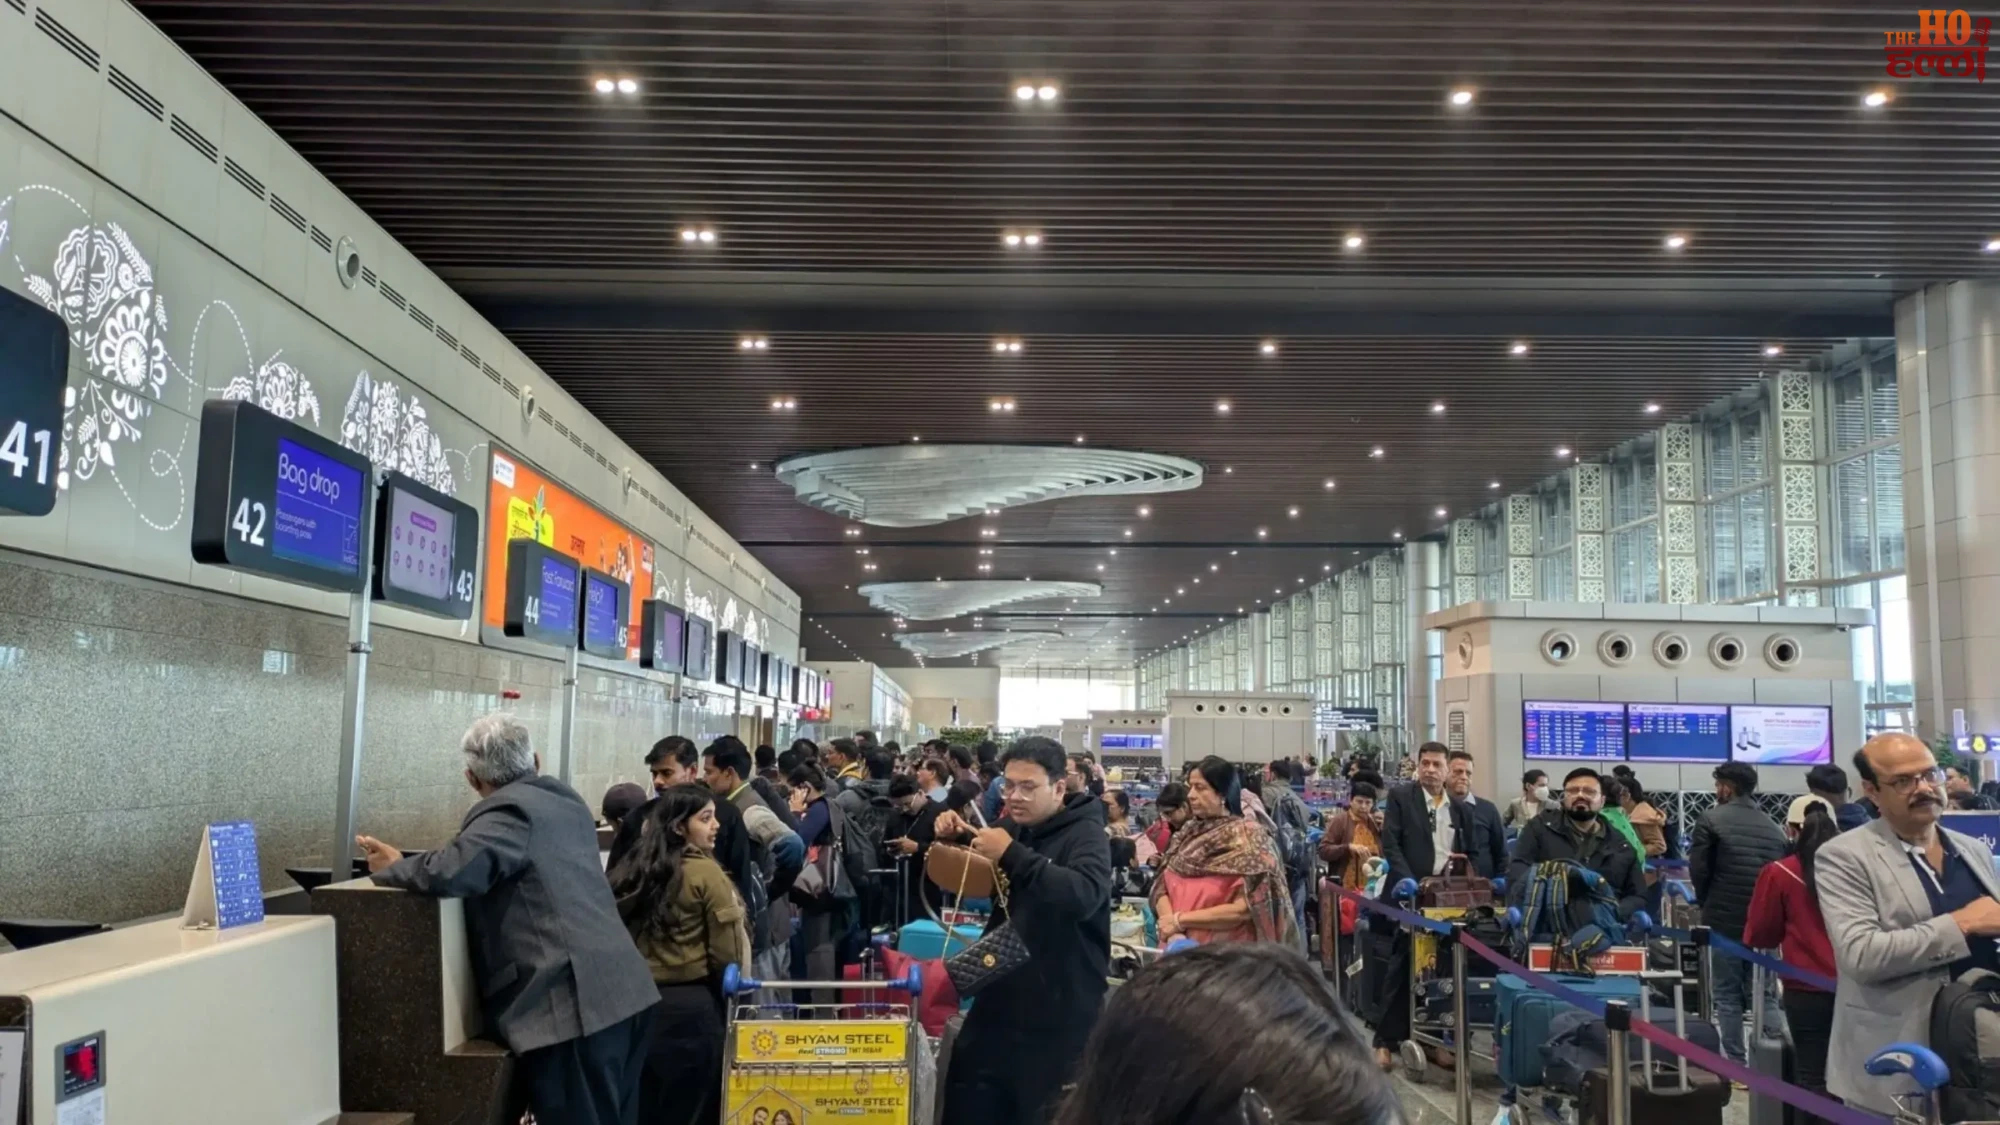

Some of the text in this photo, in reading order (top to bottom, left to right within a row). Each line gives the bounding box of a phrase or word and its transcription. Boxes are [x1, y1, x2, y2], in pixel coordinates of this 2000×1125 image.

[0, 420, 51, 485] 41
[278, 452, 340, 504] Bag drop
[232, 497, 266, 547] 42
[456, 569, 473, 602] 43
[525, 595, 539, 625] 44
[618, 626, 628, 648] 45
[785, 1034, 894, 1045] SHYAM STEEL
[815, 1098, 904, 1107] SHYAM STEEL
